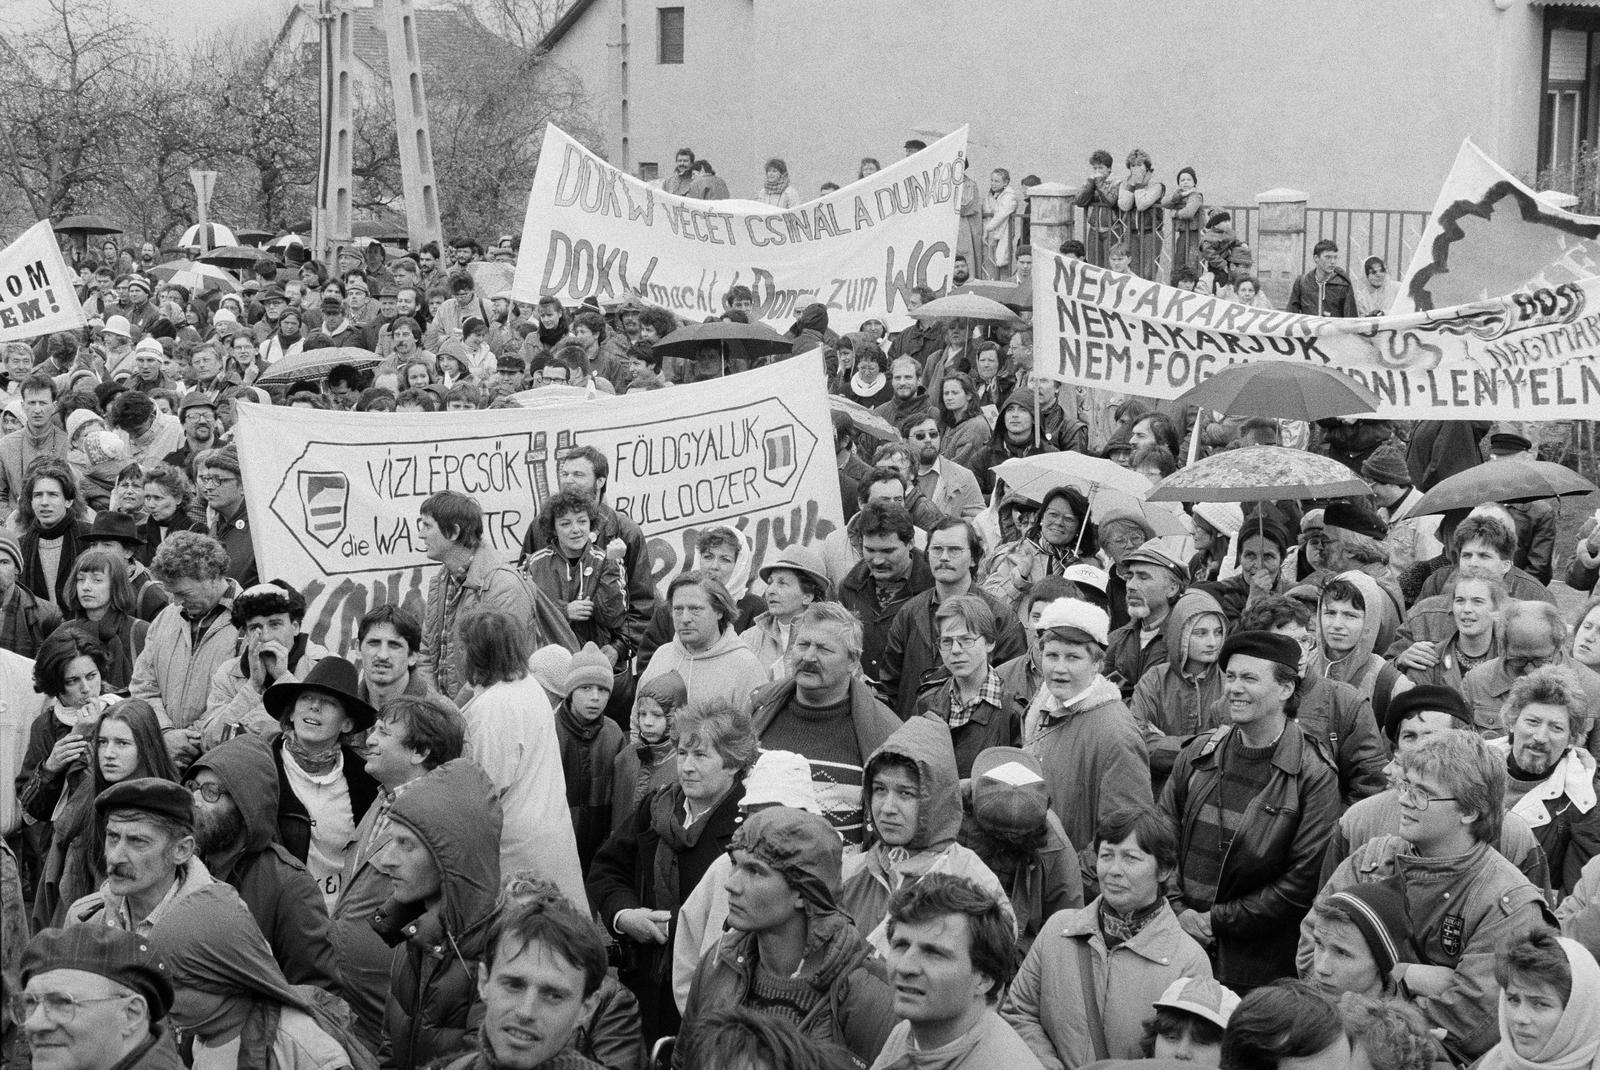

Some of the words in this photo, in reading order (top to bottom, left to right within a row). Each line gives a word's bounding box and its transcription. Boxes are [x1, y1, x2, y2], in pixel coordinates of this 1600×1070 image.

[554, 144, 654, 227] DOKW
[744, 202, 851, 248] CSINÁL
[854, 195, 874, 231] A
[0, 260, 50, 302] OM
[540, 230, 659, 299] DOKW
[649, 268, 718, 314] macht
[750, 267, 820, 321] Don
[825, 276, 878, 312] zum
[885, 239, 951, 314] WC
[1053, 255, 1132, 309] NEM
[1056, 295, 1132, 341] NEM
[1141, 319, 1331, 364] AKARJUK
[1058, 337, 1131, 384] NEM
[367, 440, 522, 500] VÍZLÉPCSŐK
[615, 415, 760, 483] FÖLDGYALUK
[615, 467, 760, 526] BULLDOZER
[341, 533, 370, 557] die
